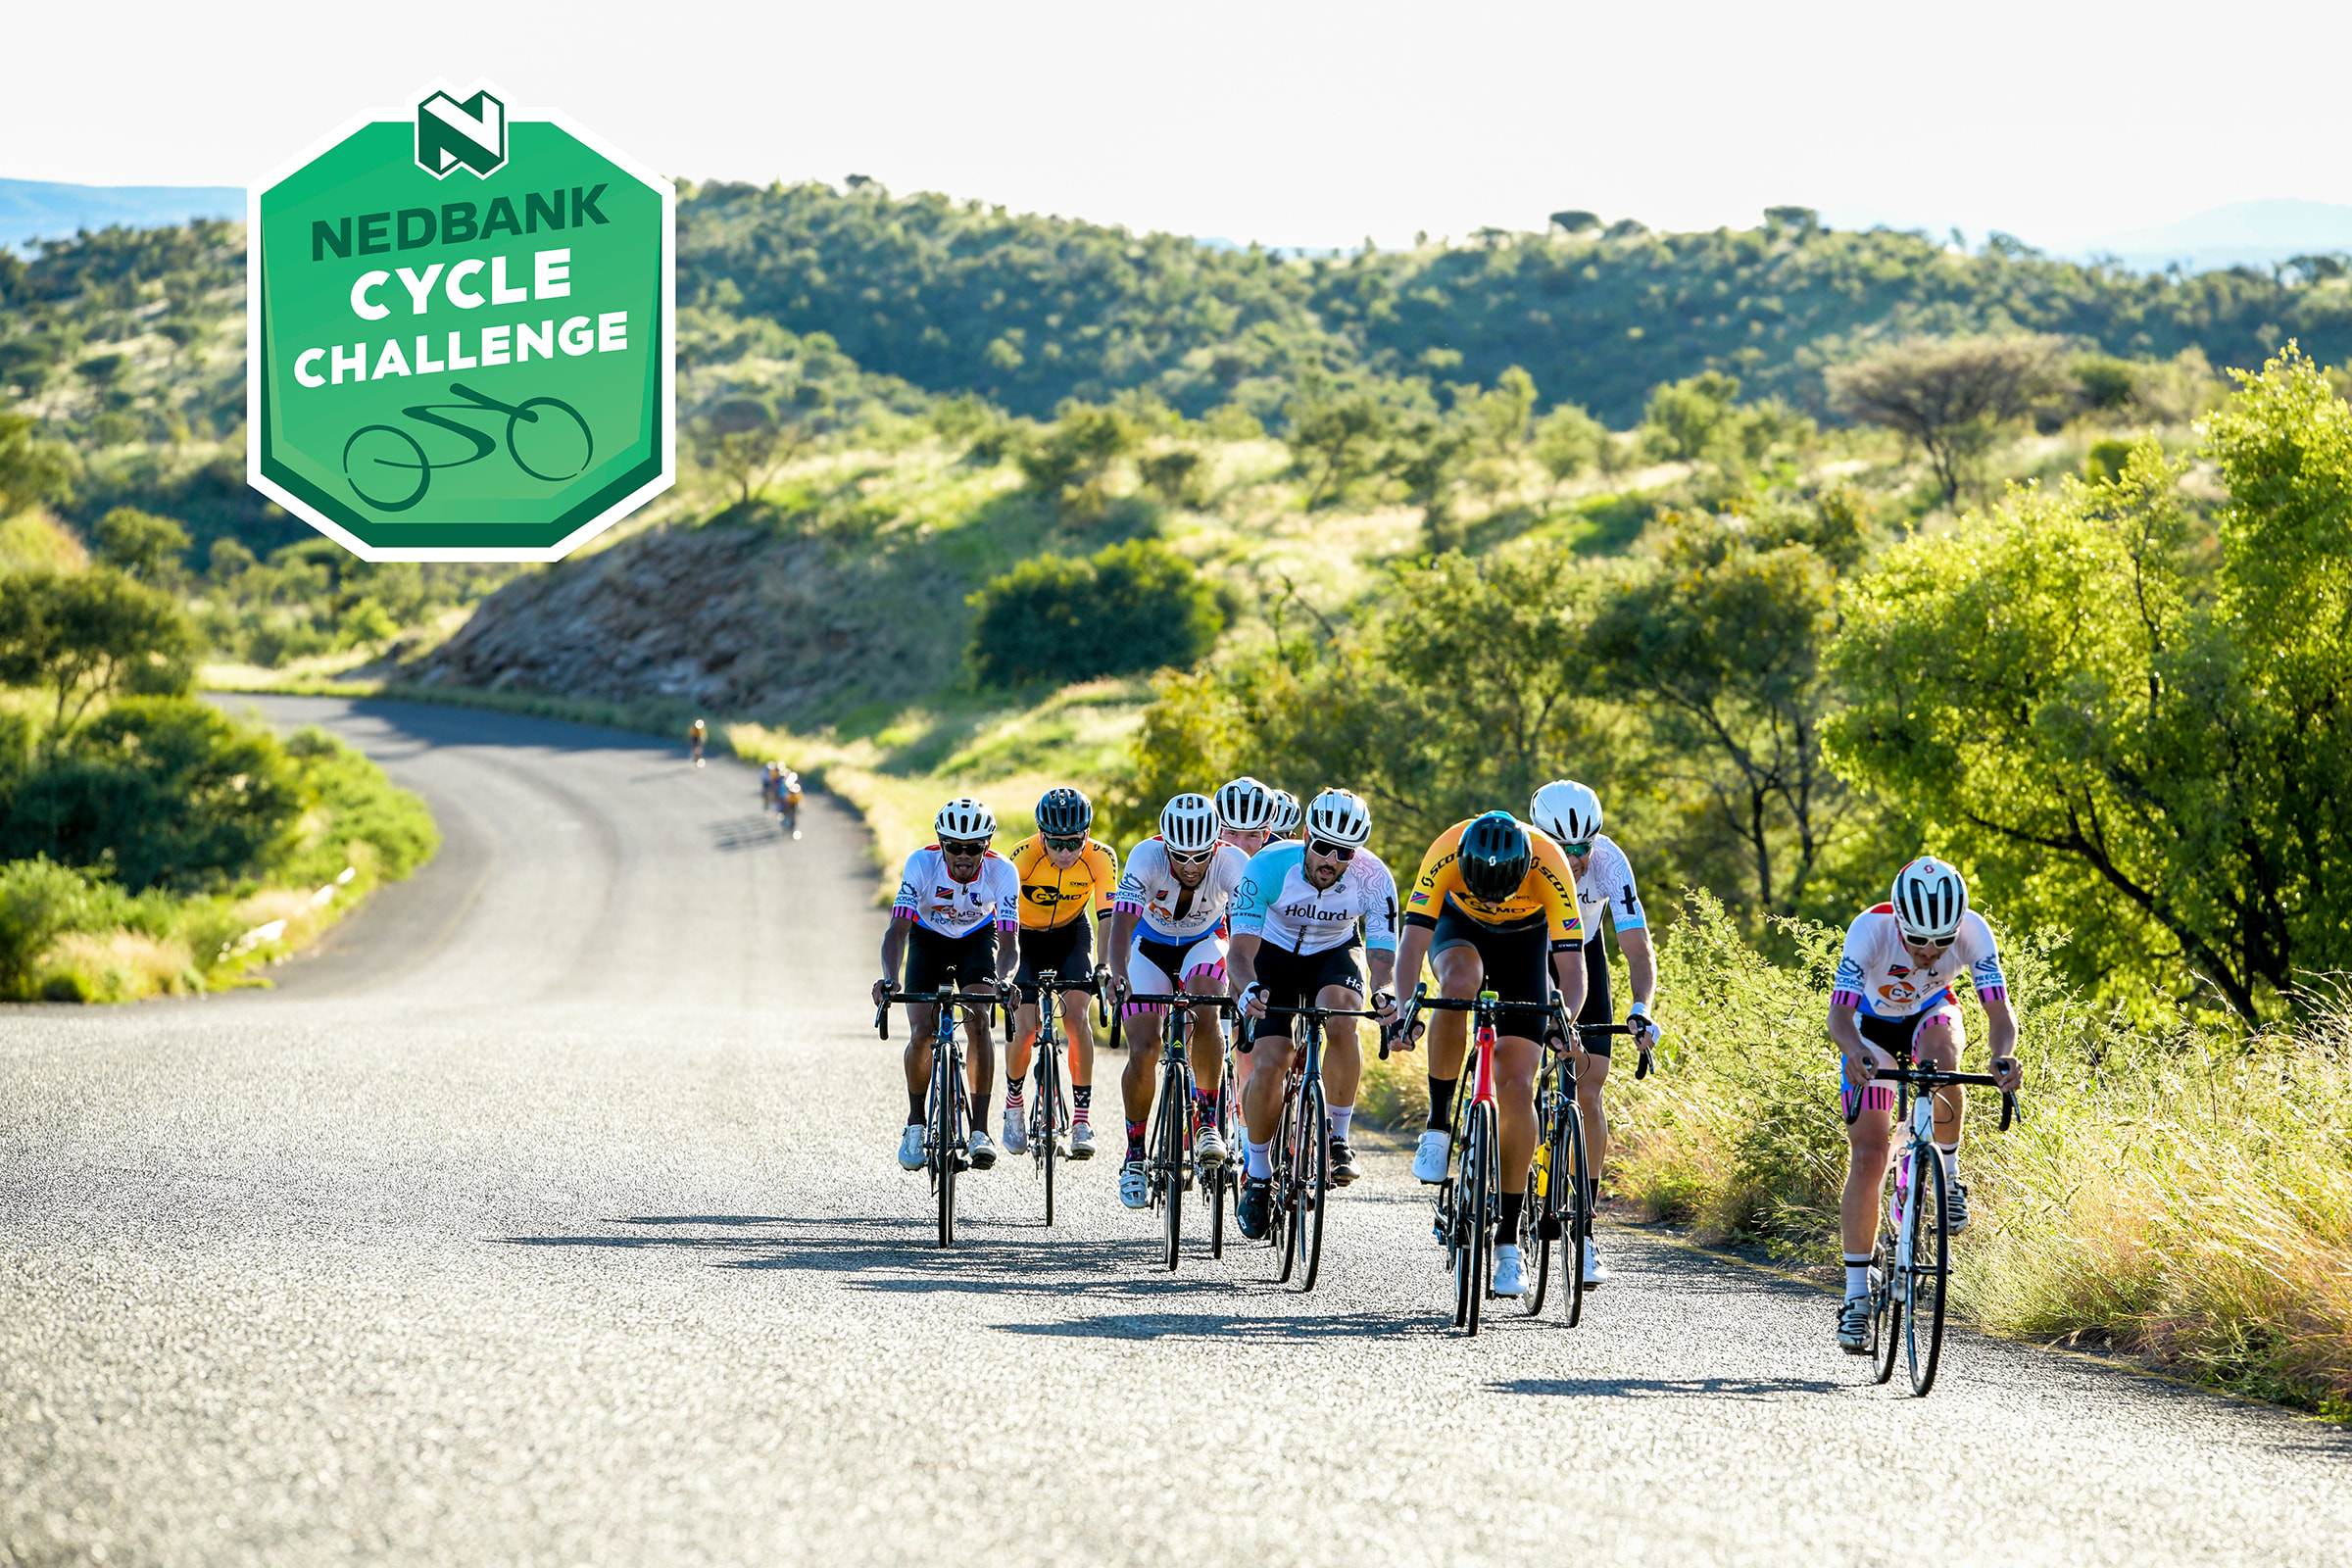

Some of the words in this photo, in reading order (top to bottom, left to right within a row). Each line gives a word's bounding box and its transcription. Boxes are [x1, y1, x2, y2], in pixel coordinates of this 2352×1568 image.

[1008, 843, 1030, 861] COTT
[1430, 853, 1456, 878] SCO
[1538, 865, 1573, 910] SCOTT
[1285, 905, 1354, 921] Hollard.
